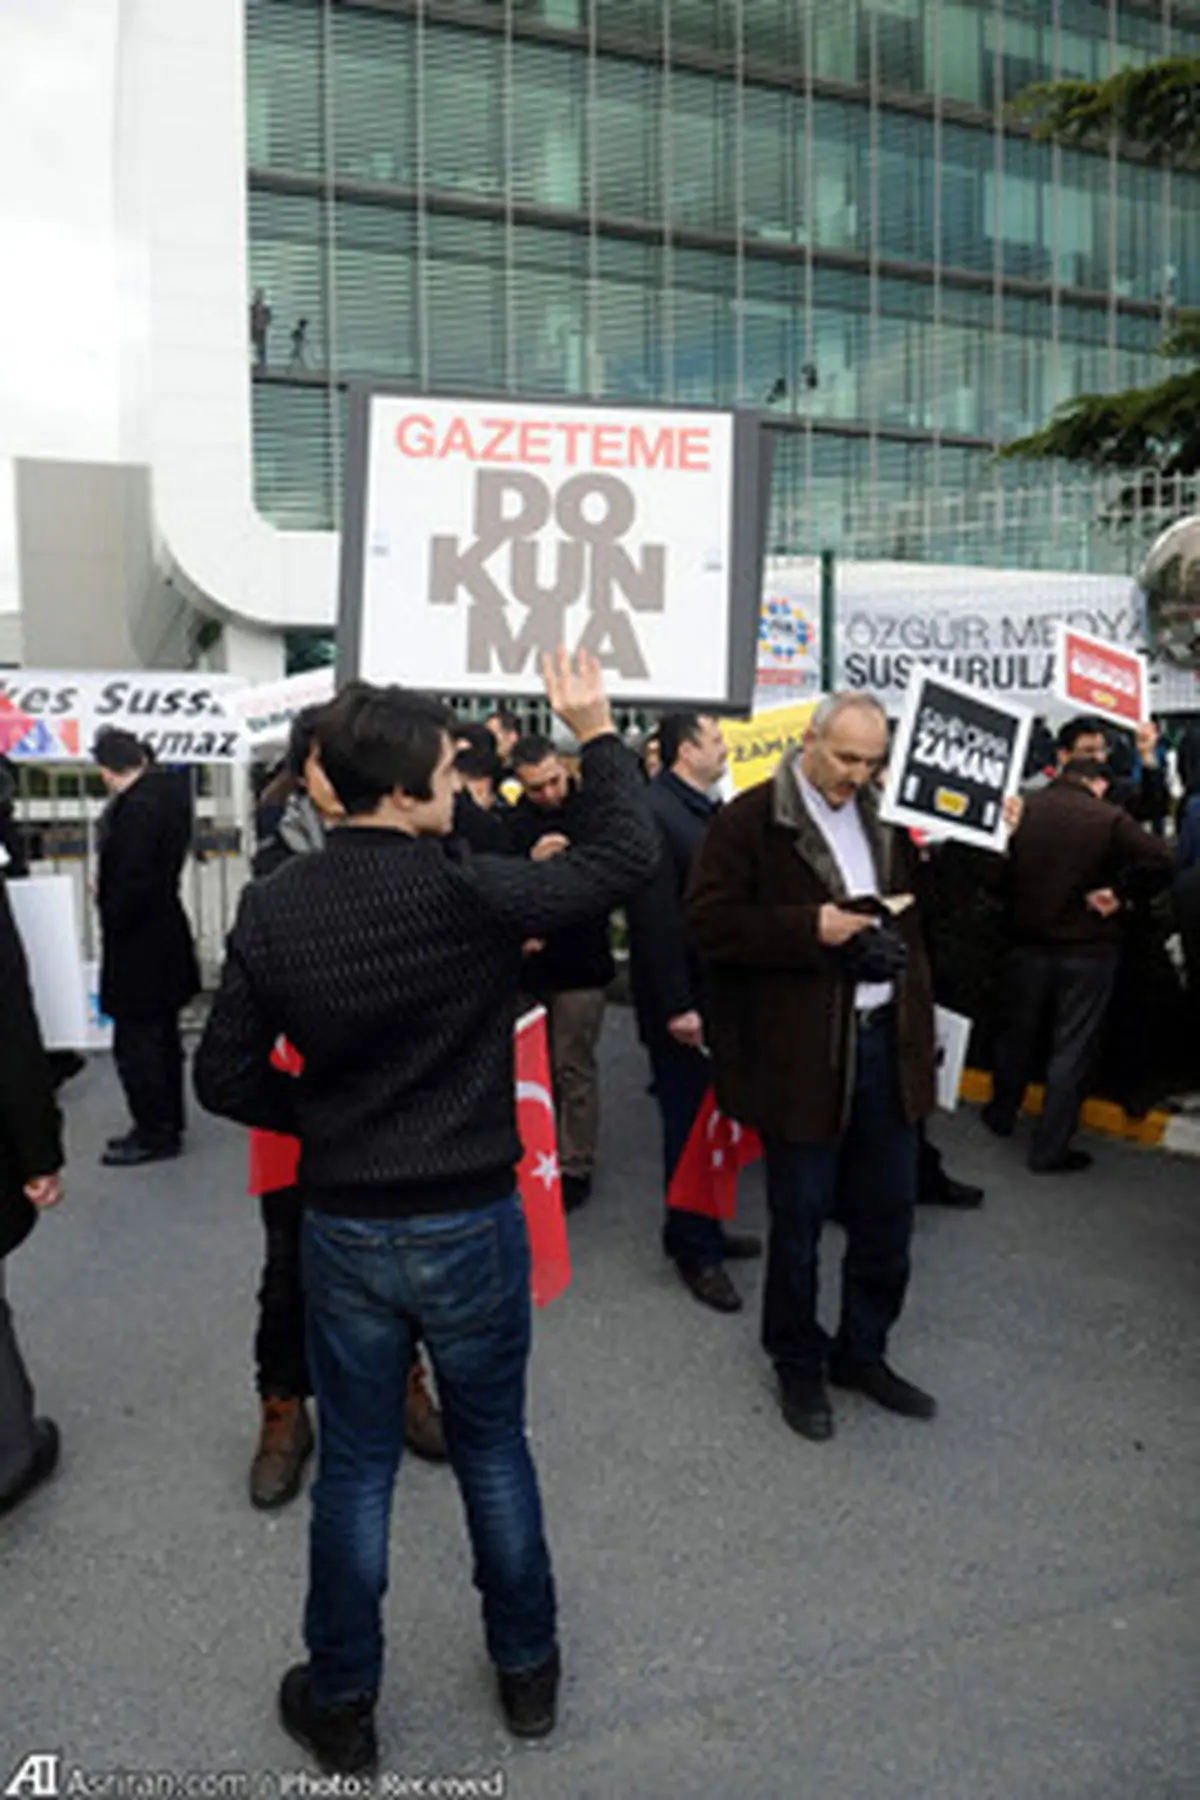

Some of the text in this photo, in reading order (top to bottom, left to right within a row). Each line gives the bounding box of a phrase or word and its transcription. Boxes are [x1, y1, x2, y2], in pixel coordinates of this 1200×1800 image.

[395, 413, 710, 471] GAZETEME
[473, 468, 636, 541] DO
[428, 534, 666, 613] KUN
[466, 603, 651, 680] MA
[845, 609, 990, 650] ÖZGÜR
